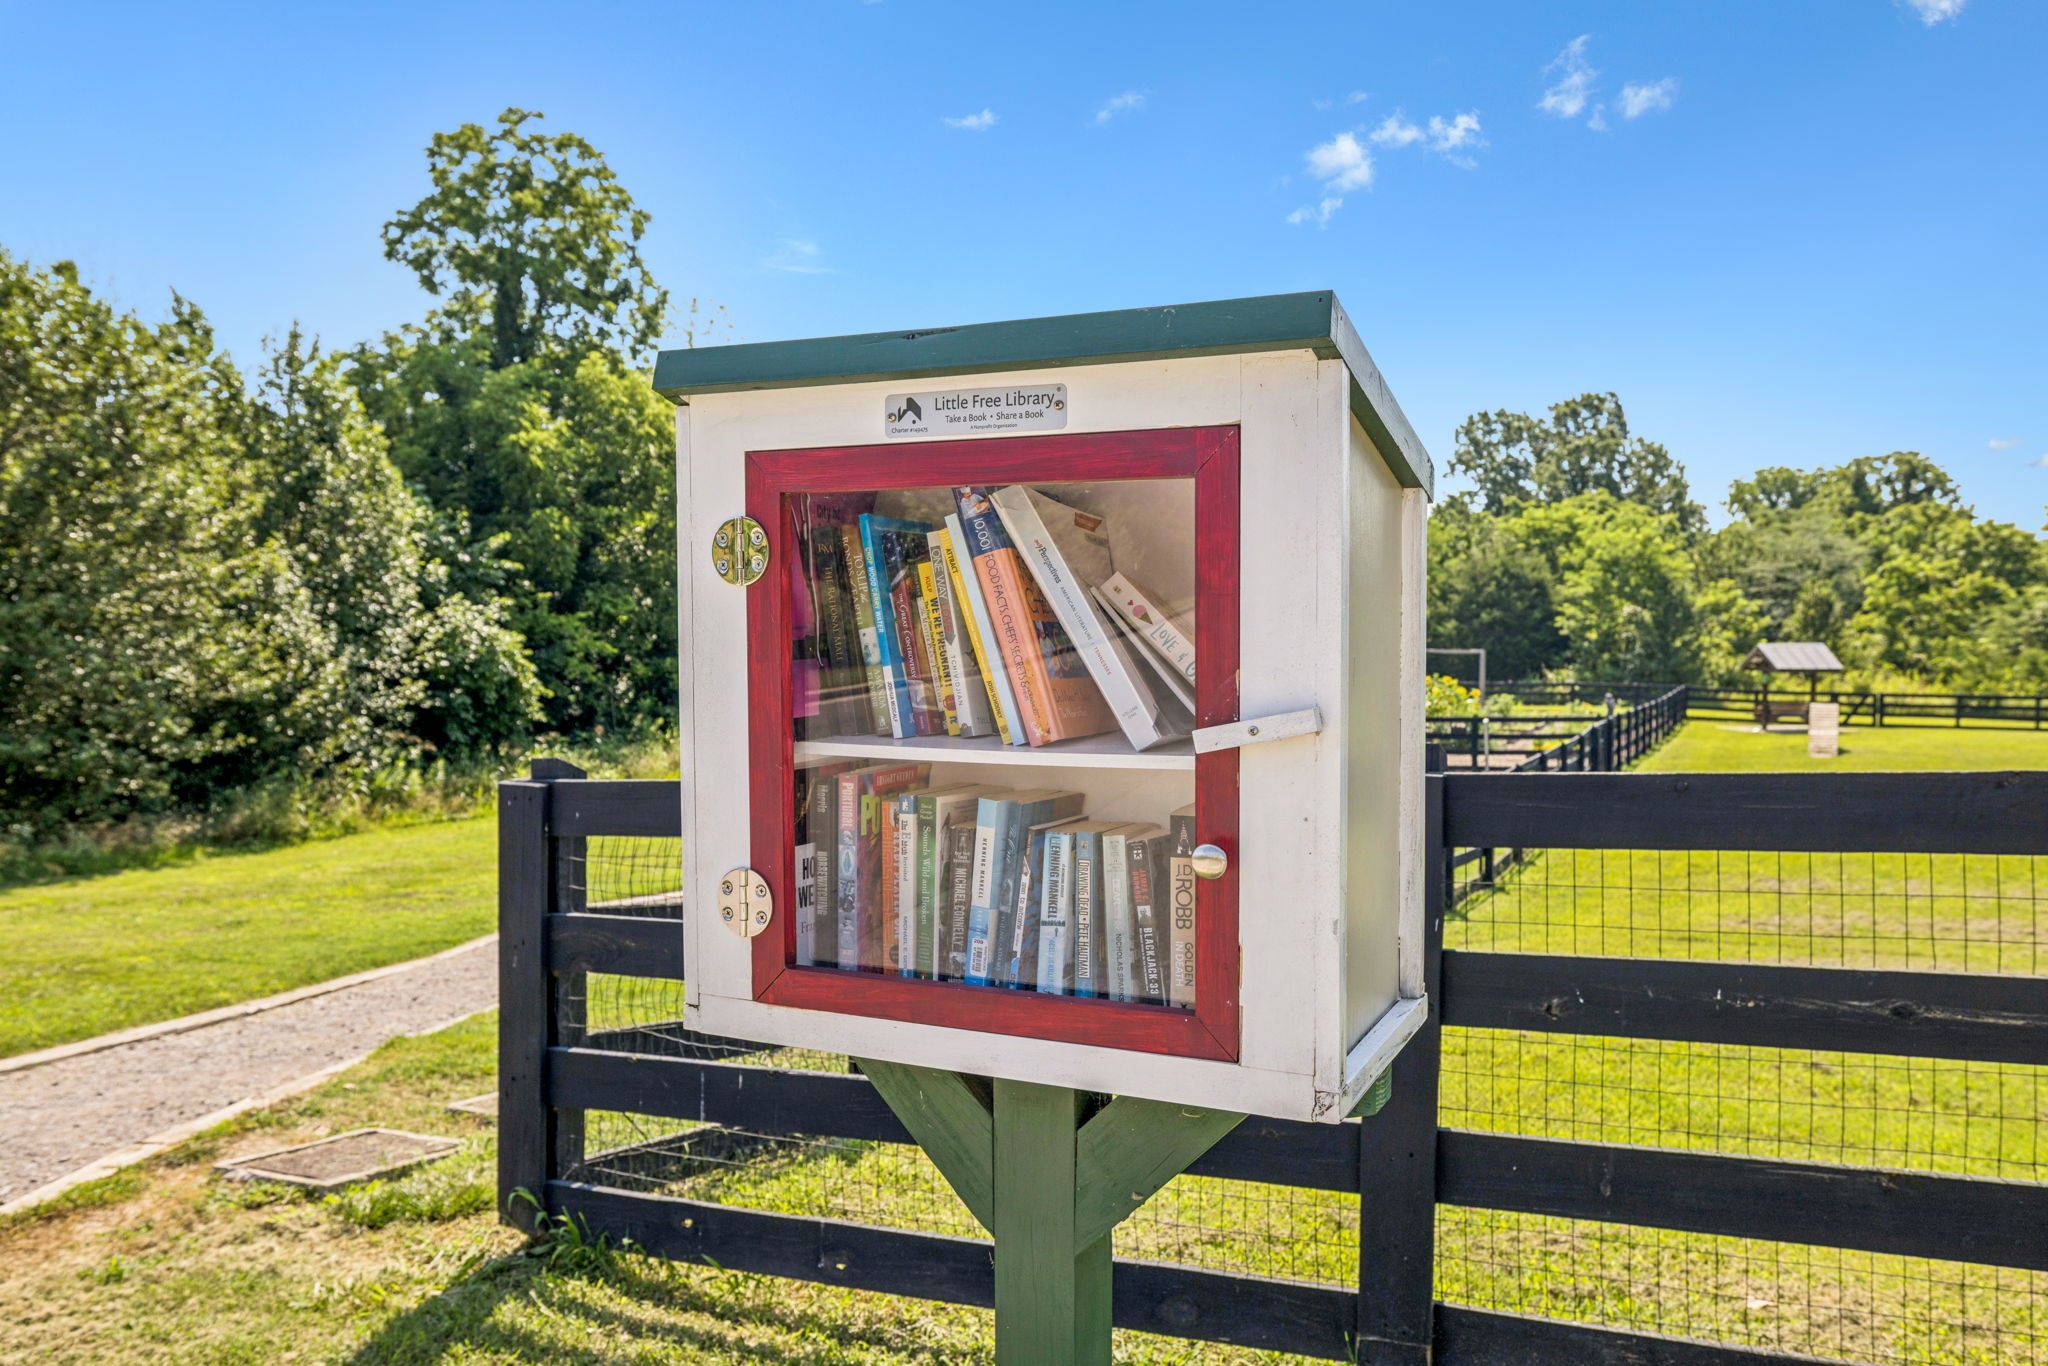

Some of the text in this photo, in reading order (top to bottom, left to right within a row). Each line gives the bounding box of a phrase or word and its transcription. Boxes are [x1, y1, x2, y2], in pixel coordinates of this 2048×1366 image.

[935, 390, 1056, 411] Little Free Library
[945, 414, 962, 424] Take
[968, 412, 987, 422] Book
[996, 410, 1017, 420] Share
[1024, 409, 1044, 419] Book
[973, 517, 991, 551] 10,001
[855, 553, 865, 570] TO
[857, 571, 868, 593] SLIP
[945, 548, 959, 574] ATTRACT
[865, 547, 884, 633] CHOP WOOD CARRY WATER
[924, 576, 932, 593] KULP
[932, 548, 954, 632] ONE WAY LOVE
[824, 566, 843, 662] THE RATIONAL MALE
[900, 603, 910, 629] GREAT
[922, 617, 932, 640] MASTER
[984, 554, 1000, 585] FOOD
[1009, 645, 1027, 681] SECRETS
[1060, 586, 1077, 615] AMERICAN
[1074, 611, 1093, 640] LITERATURE
[1093, 646, 1112, 676] TENNESSEE
[902, 629, 917, 680] CONTROVERSY
[1150, 623, 1180, 653] LOVE
[874, 668, 887, 709] AMANDA
[950, 655, 963, 706] TCHIVIDJIAN
[986, 680, 995, 694] JOSH
[886, 681, 899, 723] JOSHUA MEDCALF
[841, 782, 854, 828] PORTUGAL
[921, 825, 931, 925] Sounds Wild and Broken
[977, 837, 989, 899] HENNING MANKELL
[1049, 837, 1062, 878] HENNING
[816, 851, 828, 916] HORSEWATCHING
[1047, 879, 1059, 919] MANKELL
[1175, 878, 1193, 930] ROBB
[952, 868, 968, 946] MICHAEL CONNELLY
[1078, 861, 1090, 977] DRAWING DEAD PETE HAUTMAN
[1115, 933, 1124, 971] NICHOLAS
[1175, 941, 1184, 987] IN DEATH
[1184, 942, 1194, 987] GOLDEN
[1117, 973, 1126, 1002] SPARKS
